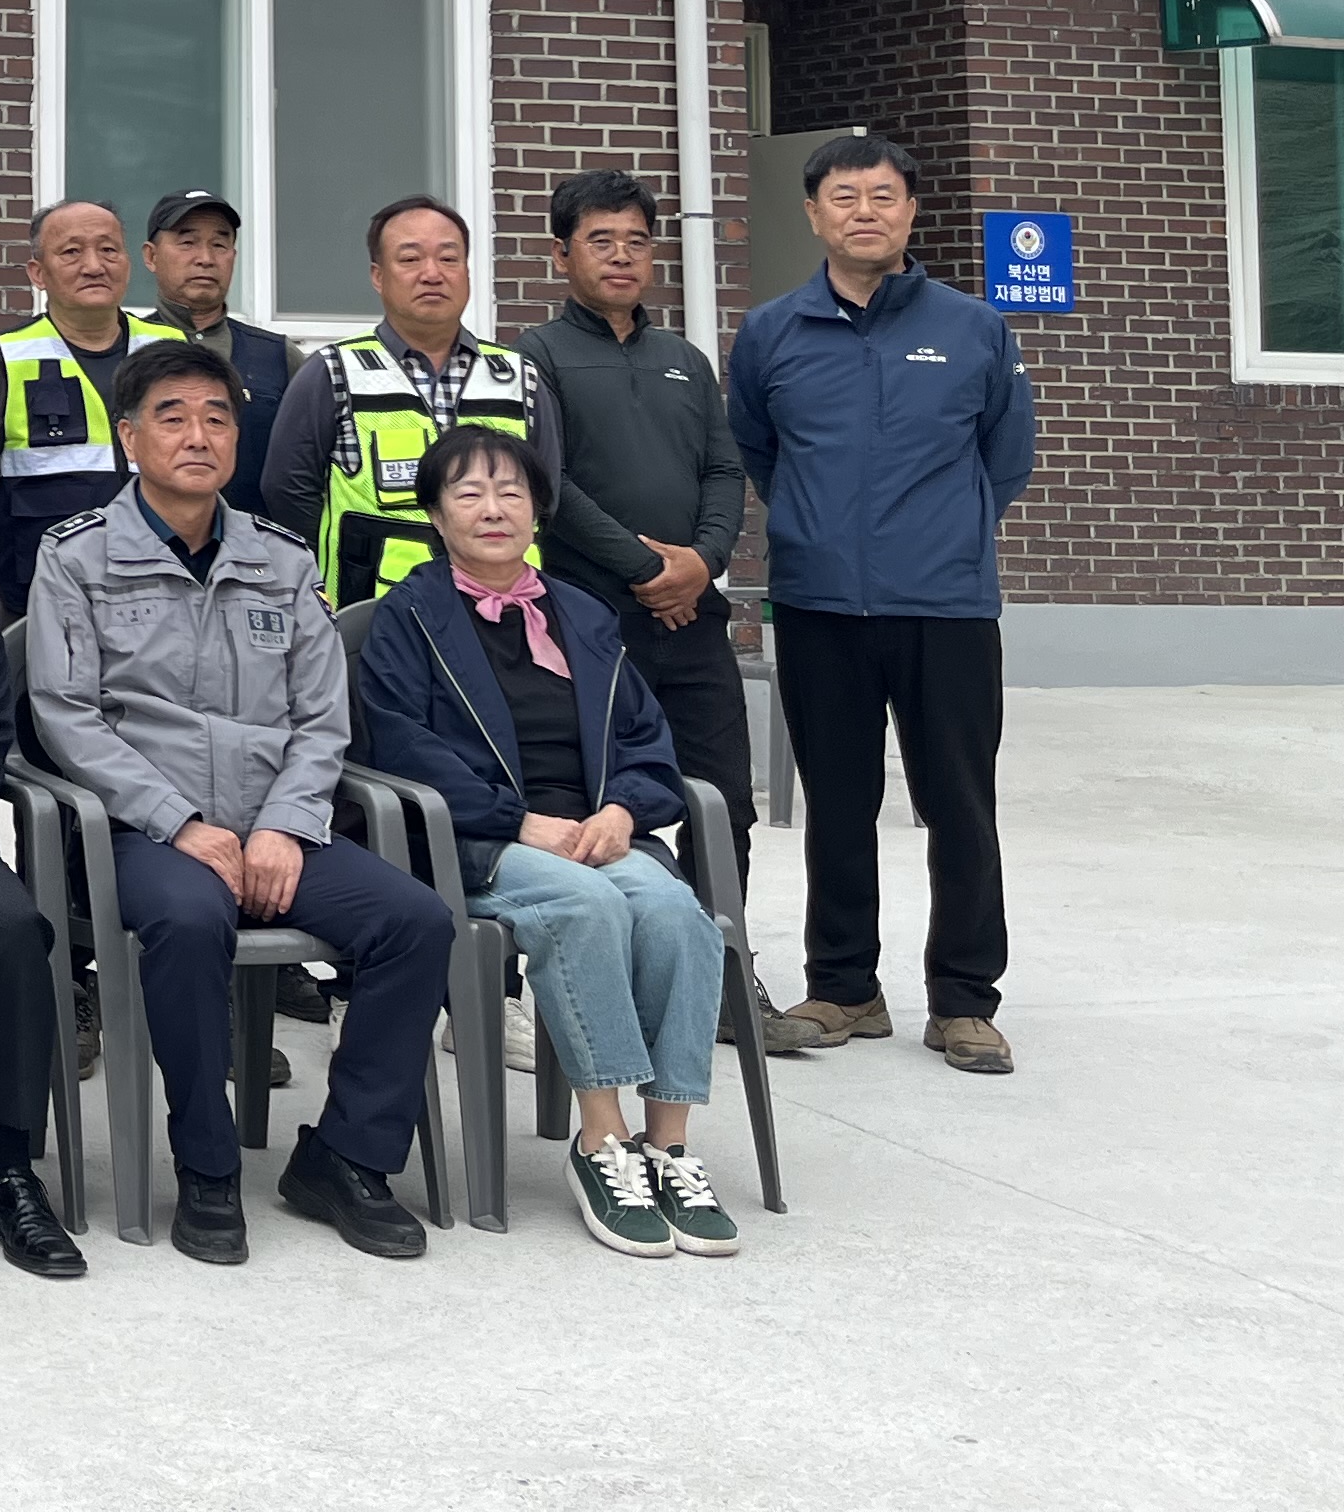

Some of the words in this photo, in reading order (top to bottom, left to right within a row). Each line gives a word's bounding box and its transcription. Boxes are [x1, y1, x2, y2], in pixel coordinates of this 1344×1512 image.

[1008, 264, 1051, 282] 북산면
[995, 284, 1067, 303] 자율방범대
[250, 610, 281, 632] 경찰
